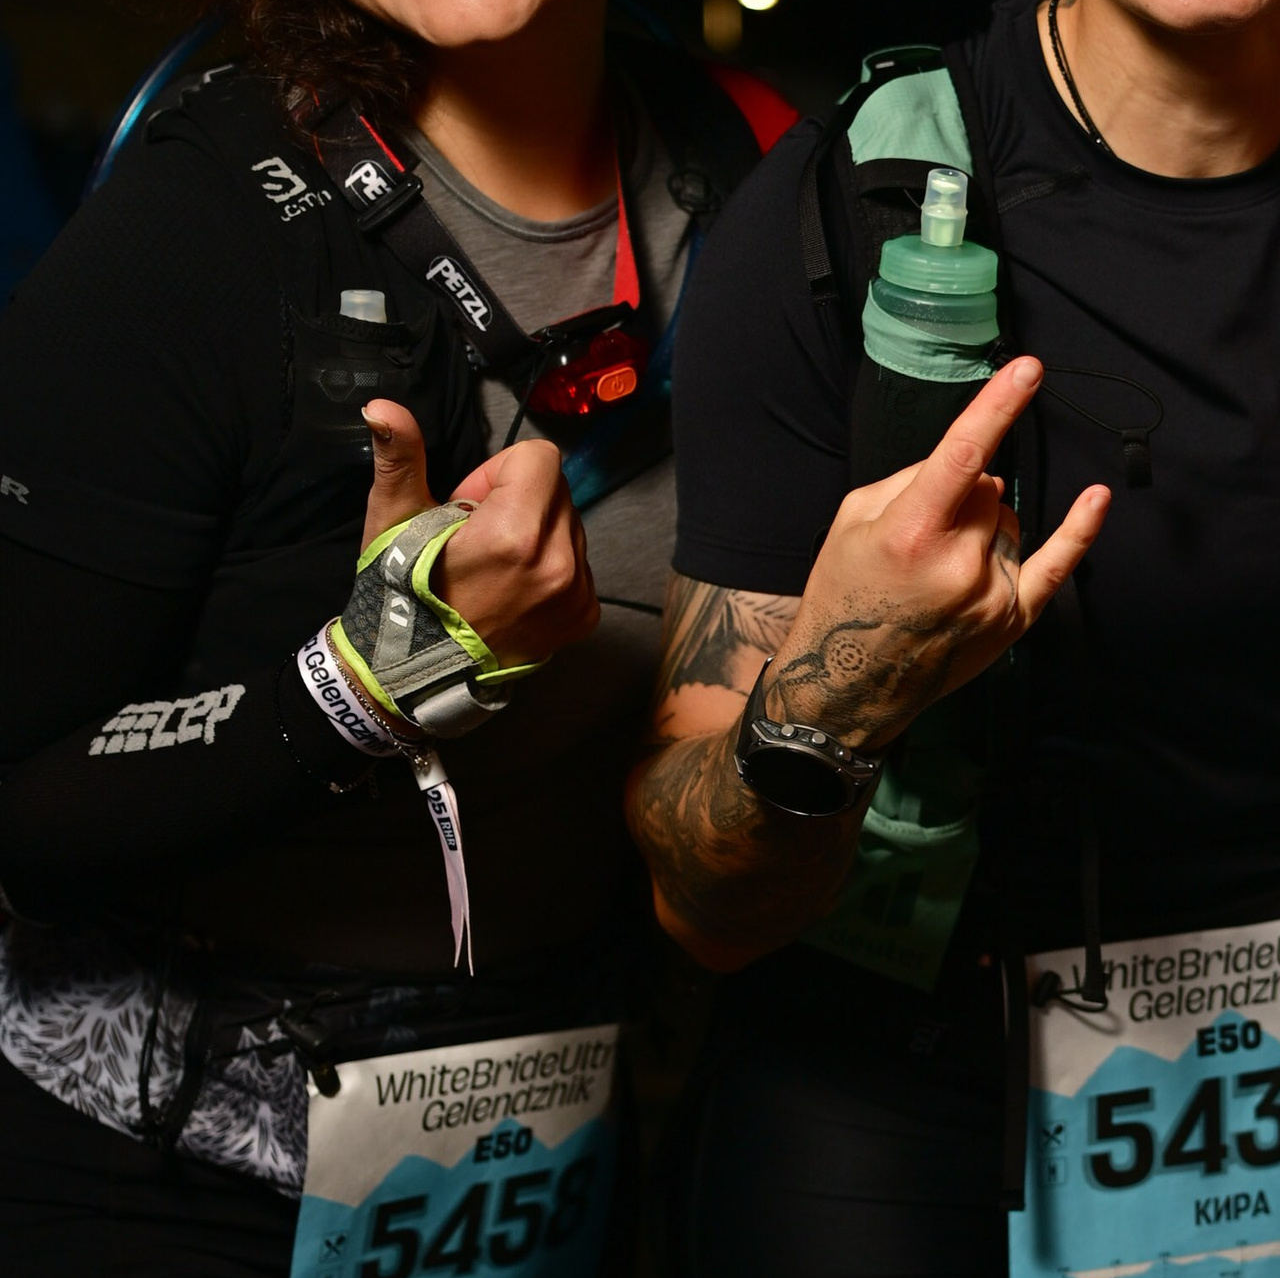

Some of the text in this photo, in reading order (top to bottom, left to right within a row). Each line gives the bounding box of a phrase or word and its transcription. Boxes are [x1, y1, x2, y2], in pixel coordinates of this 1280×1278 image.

[425, 258, 492, 332] PETZL
[1197, 1021, 1262, 1057] E50
[376, 1040, 613, 1107] WhiteBrideUltr
[422, 1073, 596, 1132] Gelendzhik
[473, 1126, 534, 1163] E50
[1195, 1190, 1271, 1226] КИРА
